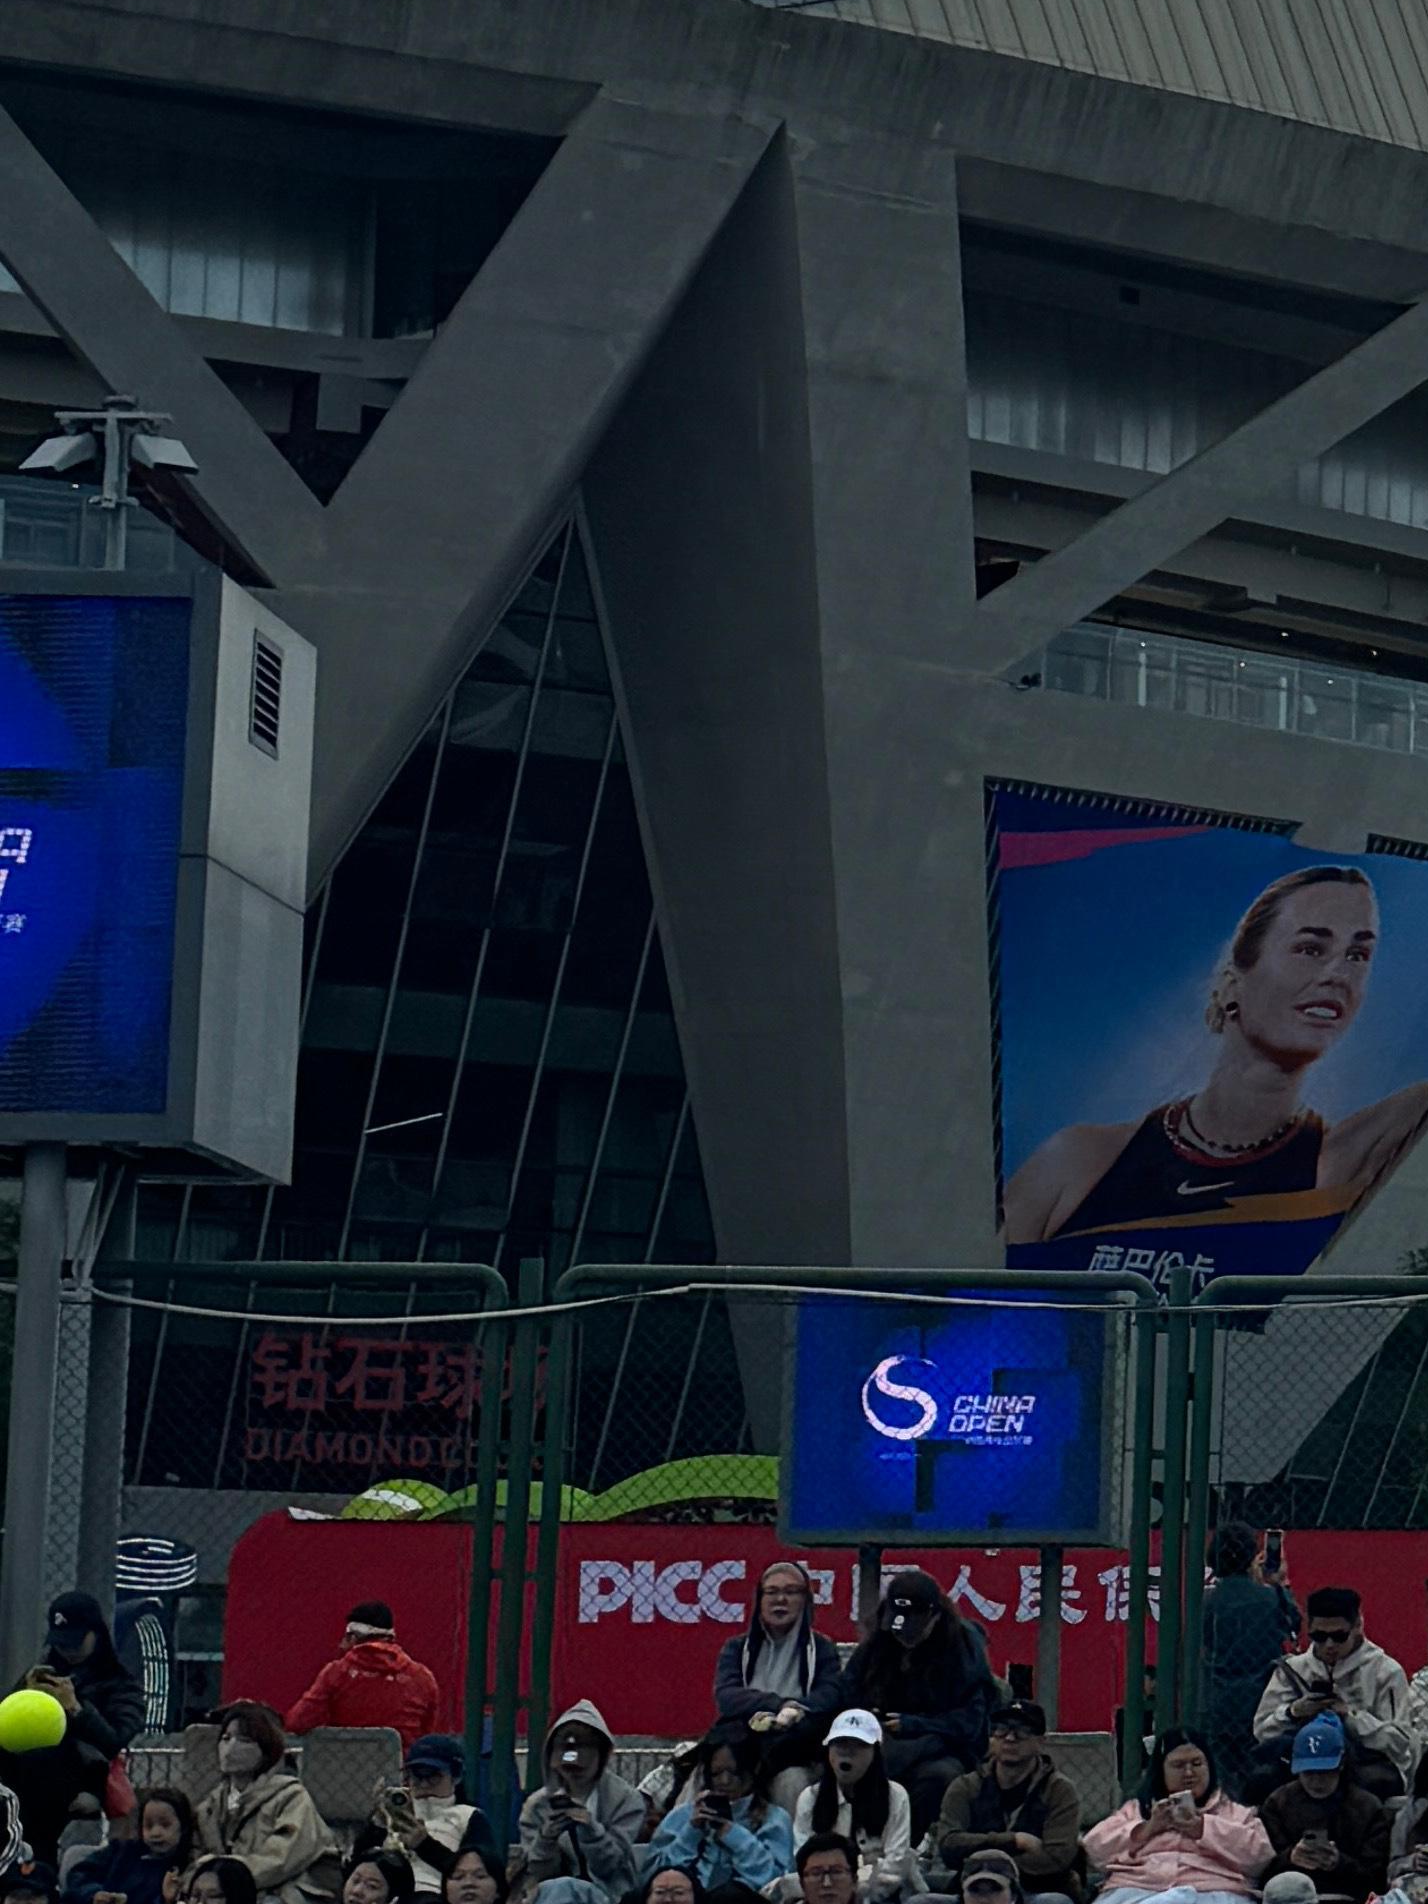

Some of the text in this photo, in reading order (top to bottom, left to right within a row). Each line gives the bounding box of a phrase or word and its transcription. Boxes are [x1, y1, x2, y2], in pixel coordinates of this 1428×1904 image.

[953, 1395, 1036, 1415] CHINA
[948, 1415, 1024, 1434] OPEN
[579, 1560, 745, 1623] PICC
